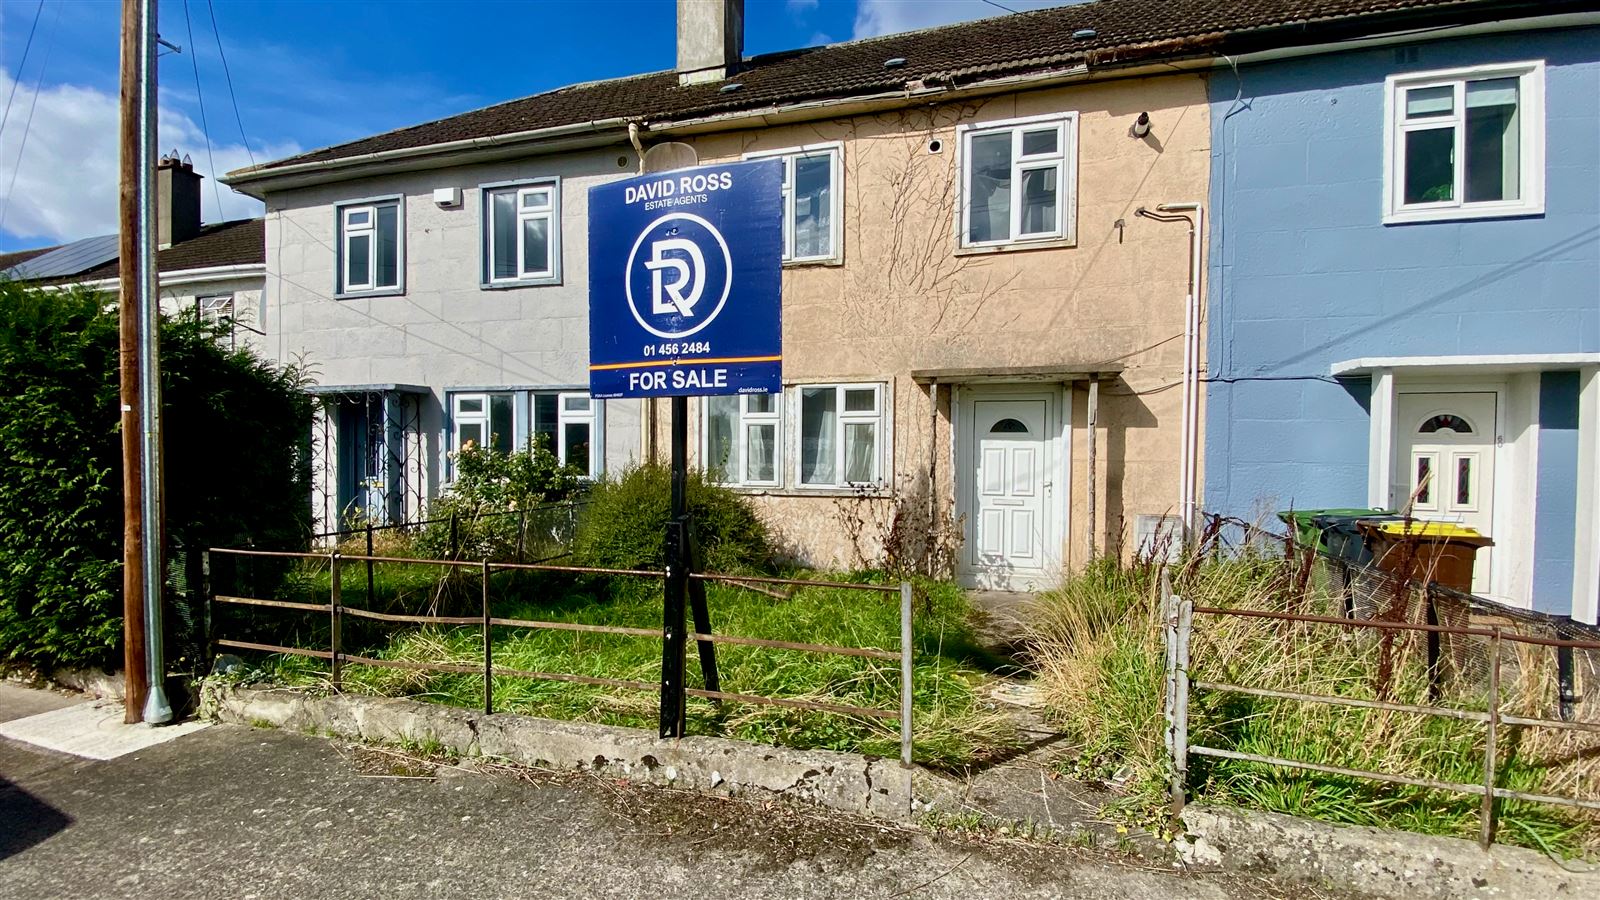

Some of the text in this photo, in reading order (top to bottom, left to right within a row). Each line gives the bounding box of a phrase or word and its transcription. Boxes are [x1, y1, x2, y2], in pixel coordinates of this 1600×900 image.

[625, 171, 733, 205] DAVID ROSS
[645, 193, 708, 211] ESTATE AGENTS
[643, 341, 711, 357] 01 456 2484
[629, 368, 728, 391] FOR SALE
